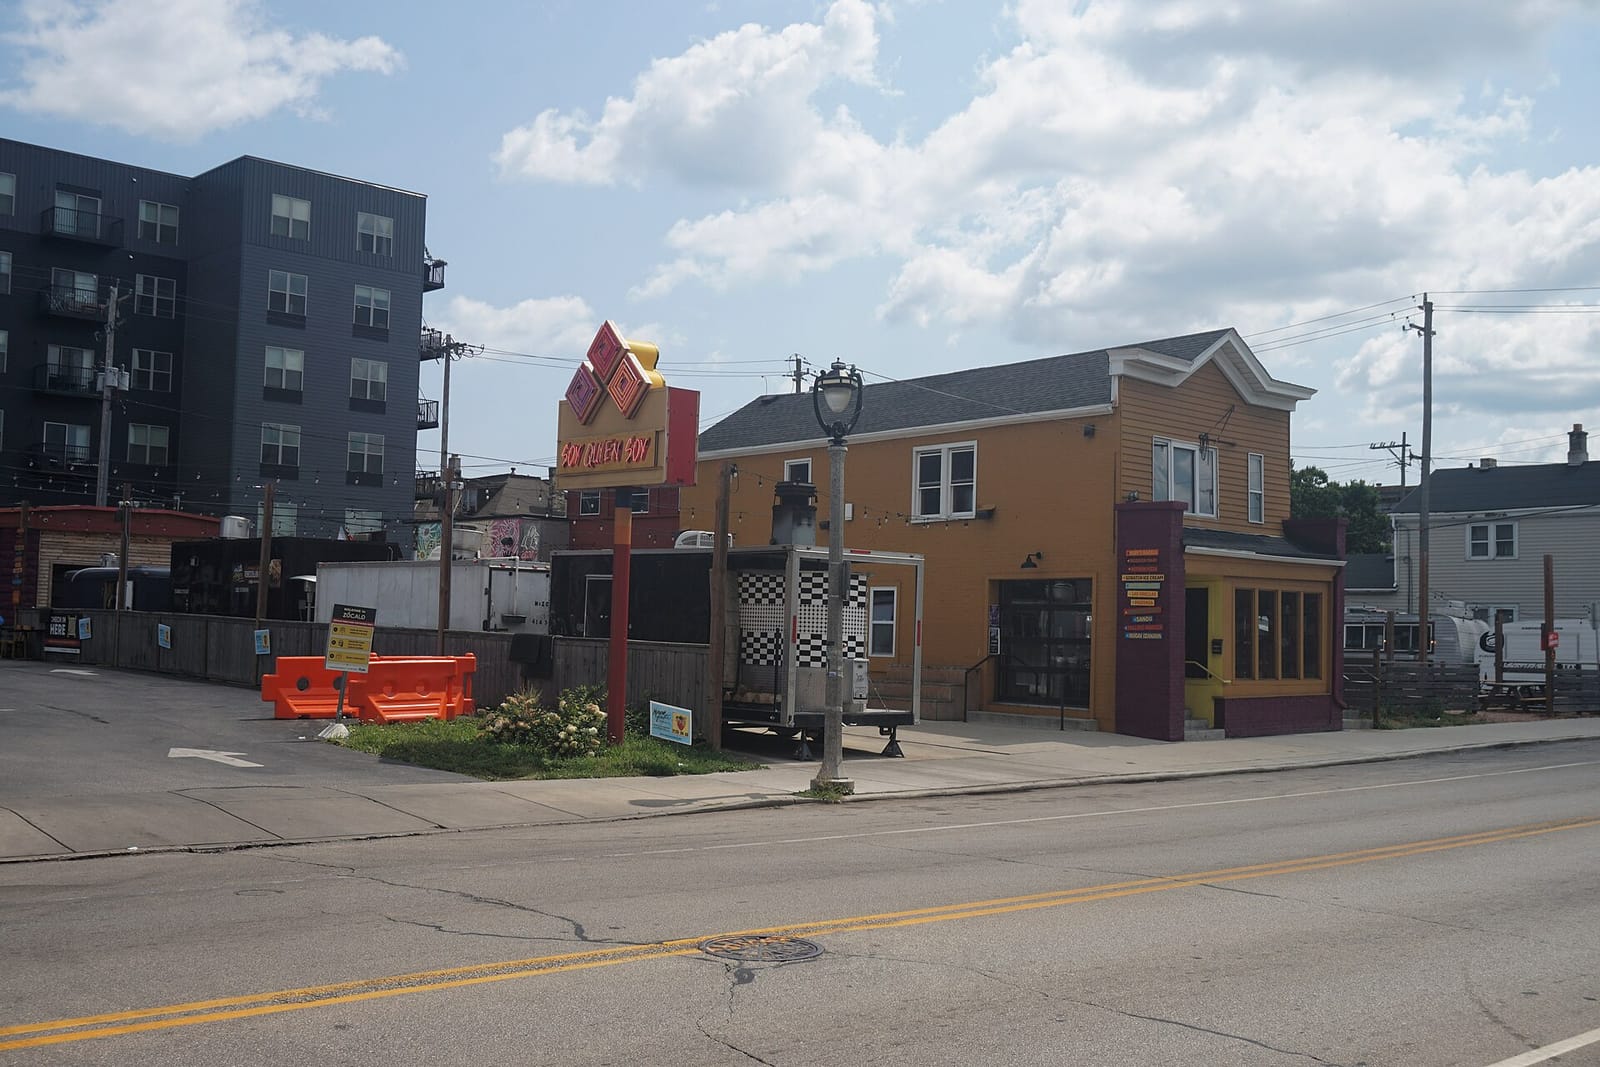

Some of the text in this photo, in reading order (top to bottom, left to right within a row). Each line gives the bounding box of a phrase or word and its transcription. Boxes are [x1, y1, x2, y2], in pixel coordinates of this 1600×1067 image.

[561, 442, 584, 468] SOY
[624, 435, 652, 463] SOY
[50, 623, 66, 636] HERE
